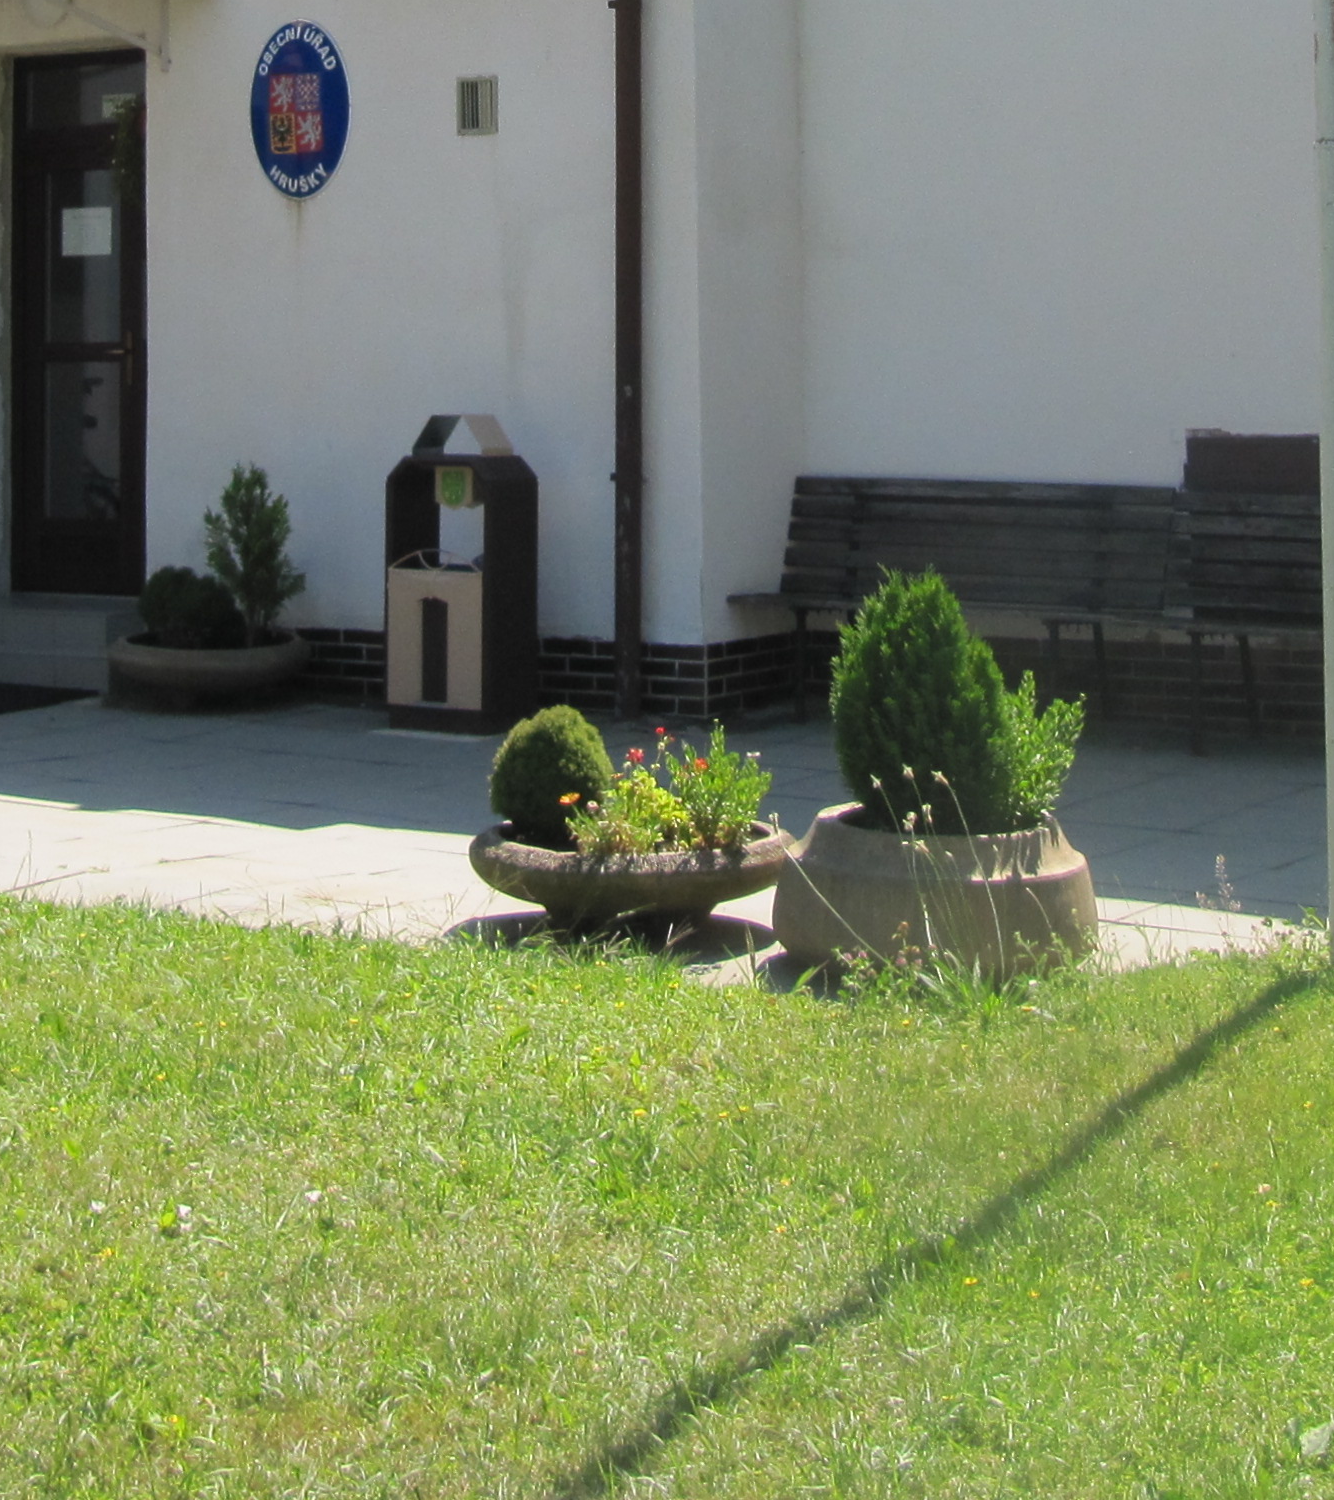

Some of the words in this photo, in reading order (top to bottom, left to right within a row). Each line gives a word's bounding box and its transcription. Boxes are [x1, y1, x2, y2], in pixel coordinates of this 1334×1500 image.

[258, 23, 302, 76] OBECNÍ
[303, 26, 337, 71] ÚŘAD
[269, 163, 327, 193] HRUŠKY
